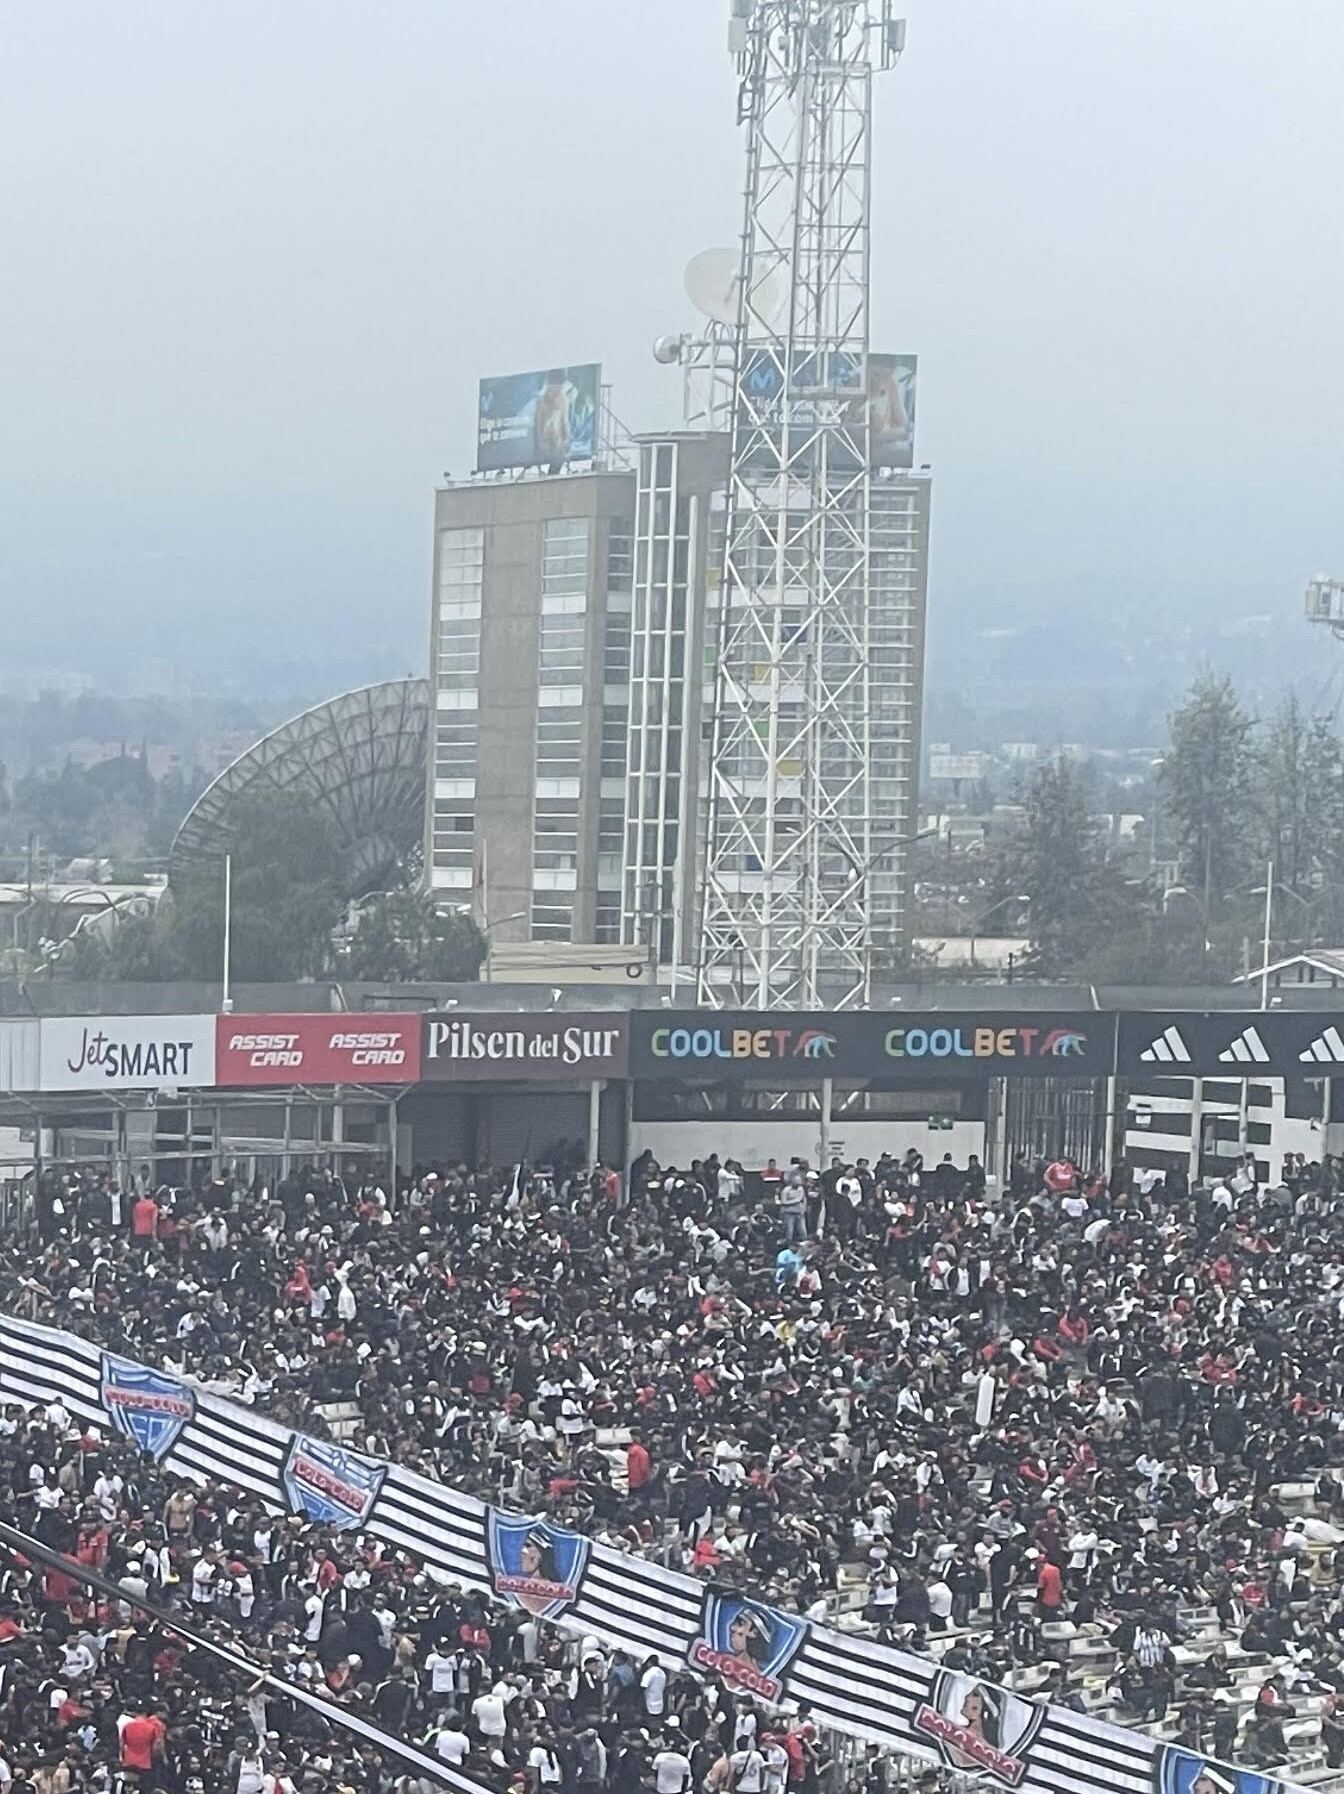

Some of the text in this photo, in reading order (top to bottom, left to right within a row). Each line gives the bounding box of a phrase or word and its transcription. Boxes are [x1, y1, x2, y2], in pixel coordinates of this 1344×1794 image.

[68, 1028, 193, 1077] JetSMART
[229, 1034, 300, 1050] ASSIST
[329, 1033, 400, 1049] ASSIST
[428, 1022, 620, 1064] Pilsen del Sur
[651, 1029, 792, 1058] COOLBET
[884, 1028, 1039, 1058] COOLBET
[251, 1050, 304, 1067] CARD
[352, 1049, 406, 1066] CARD
